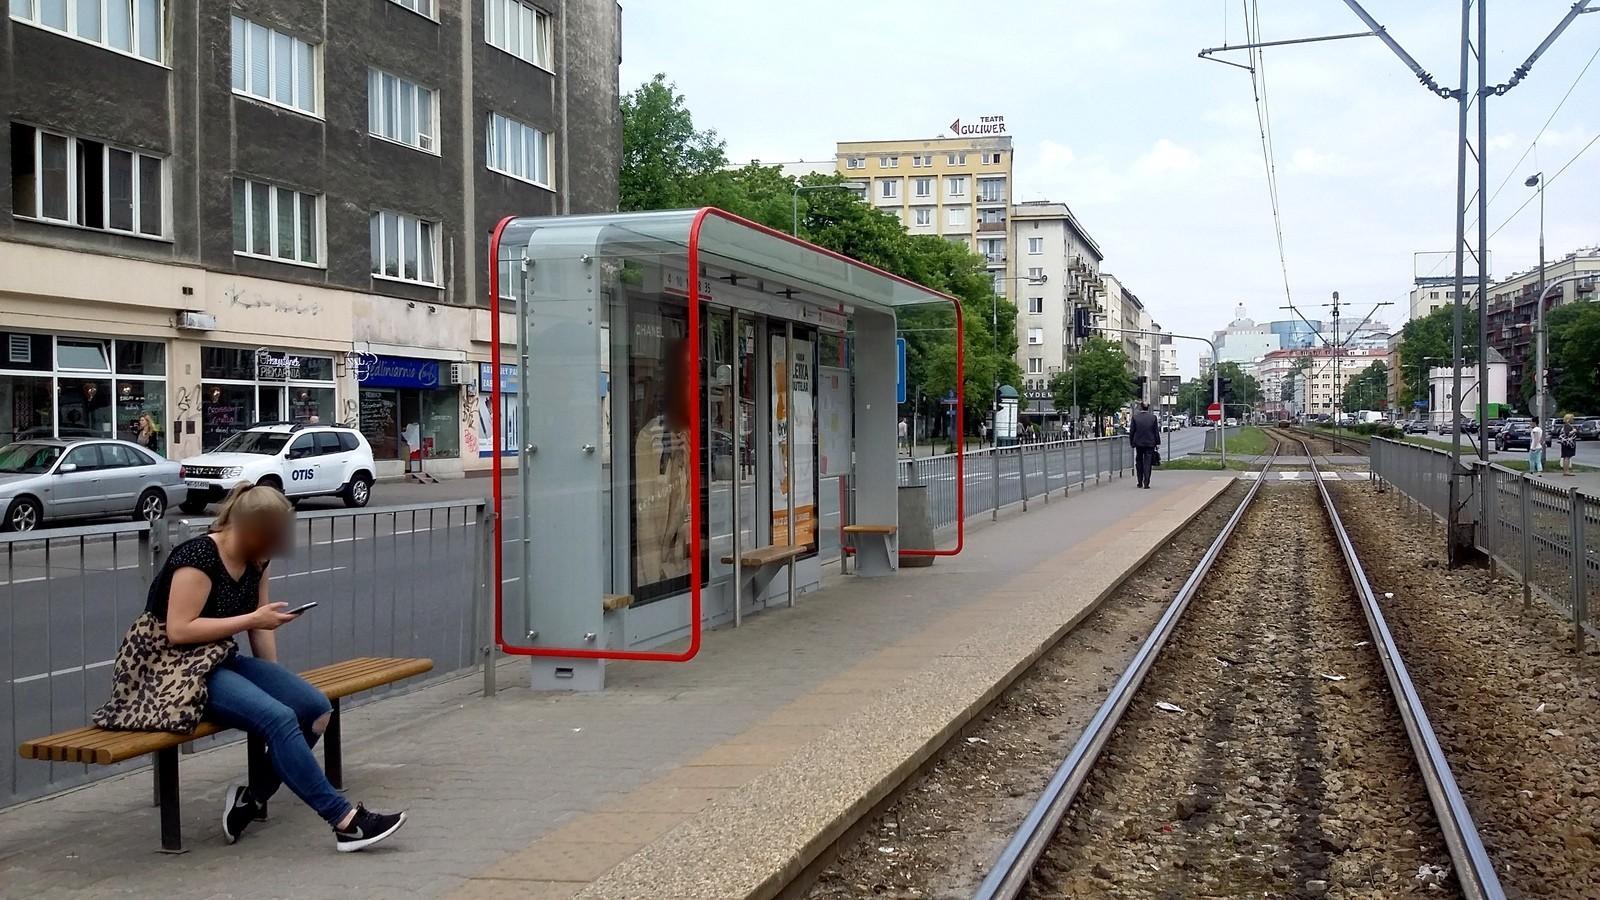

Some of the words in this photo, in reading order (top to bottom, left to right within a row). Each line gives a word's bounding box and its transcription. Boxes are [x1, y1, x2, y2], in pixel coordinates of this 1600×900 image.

[961, 123, 1006, 135] GULIWER
[704, 281, 711, 294] 35
[634, 323, 665, 339] CHANEL
[260, 366, 301, 379] PIEKARNIA
[291, 468, 314, 481] OTIS
